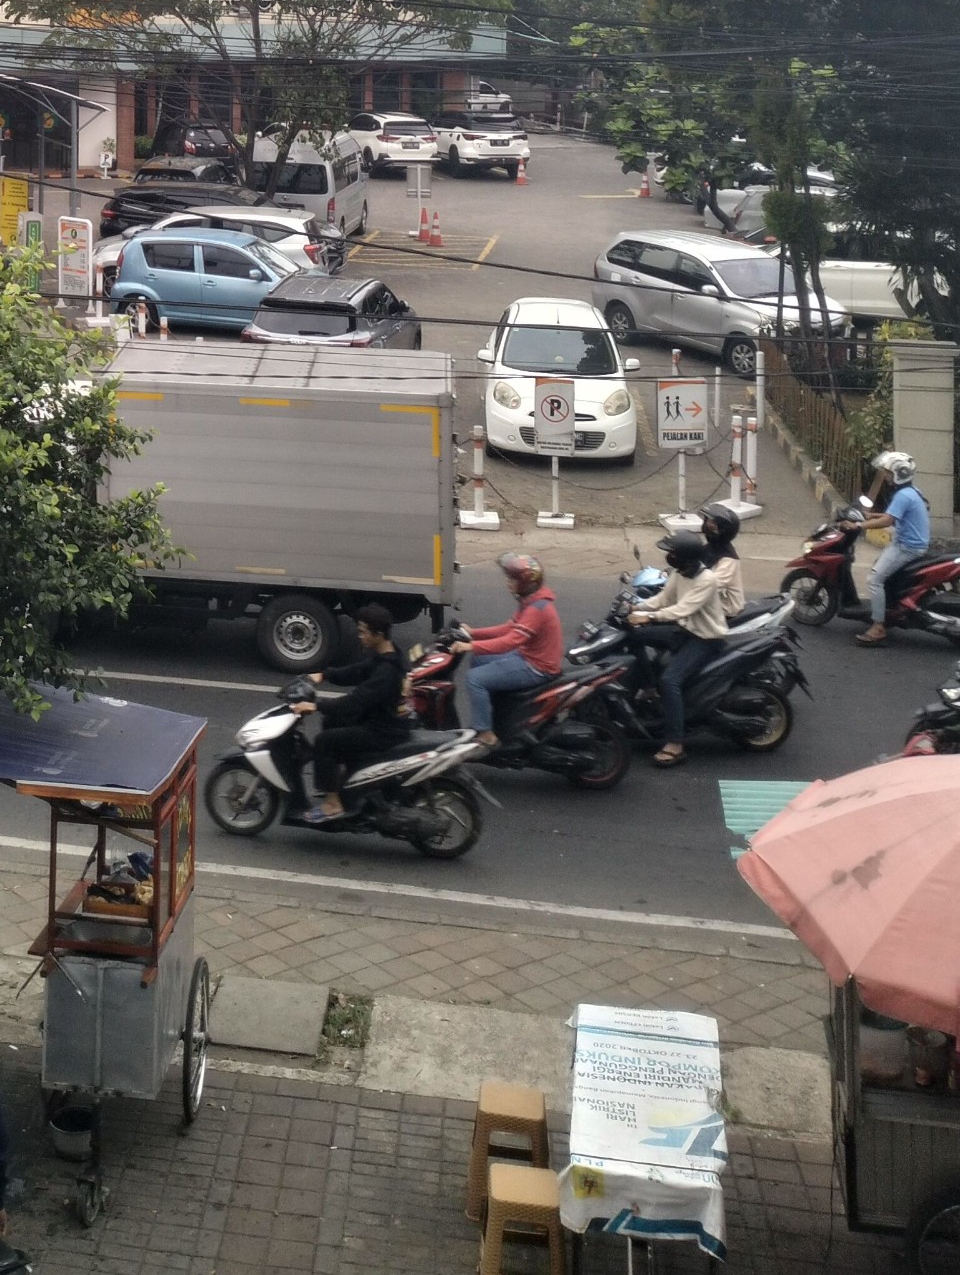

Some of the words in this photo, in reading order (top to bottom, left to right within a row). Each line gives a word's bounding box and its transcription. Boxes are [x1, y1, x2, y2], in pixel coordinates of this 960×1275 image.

[662, 431, 688, 441] PEJALAN
[689, 432, 704, 441] KAKI
[593, 1042, 617, 1050] 2020
[592, 1065, 641, 1079] ENERGI
[577, 1070, 652, 1087] INDONESIA
[590, 1104, 636, 1116] LISTRIK
[606, 1113, 637, 1123] HARI
